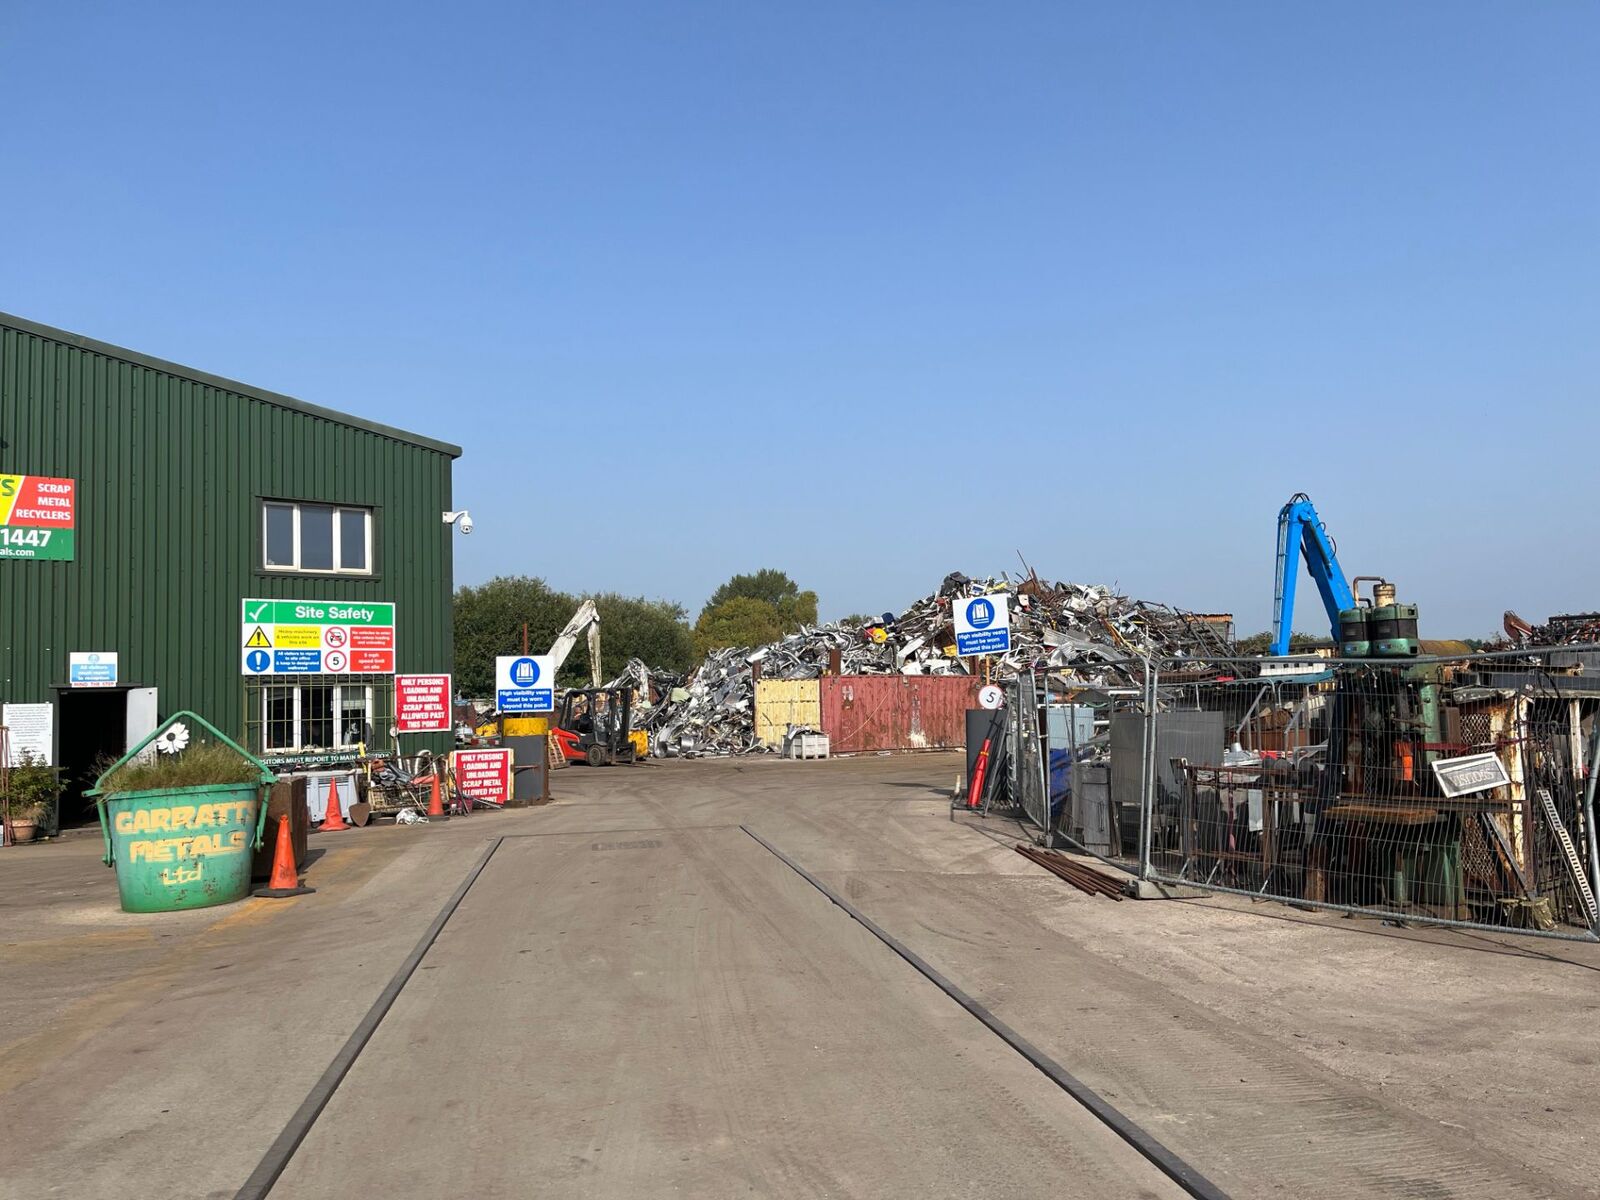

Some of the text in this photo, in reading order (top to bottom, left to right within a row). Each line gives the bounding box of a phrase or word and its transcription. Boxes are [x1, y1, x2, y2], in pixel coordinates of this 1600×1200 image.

[38, 483, 71, 494] SCRAP
[38, 496, 71, 507] METAL
[16, 509, 71, 520] RECYCLERS
[295, 606, 374, 622] Site Safety
[333, 657, 339, 665] 5
[986, 691, 996, 703] 5
[401, 712, 429, 720] ALLOWED
[463, 762, 488, 770] LOADING
[466, 770, 499, 779] UNLOADING
[130, 831, 248, 864] METALS
[162, 862, 203, 886] Ltd
